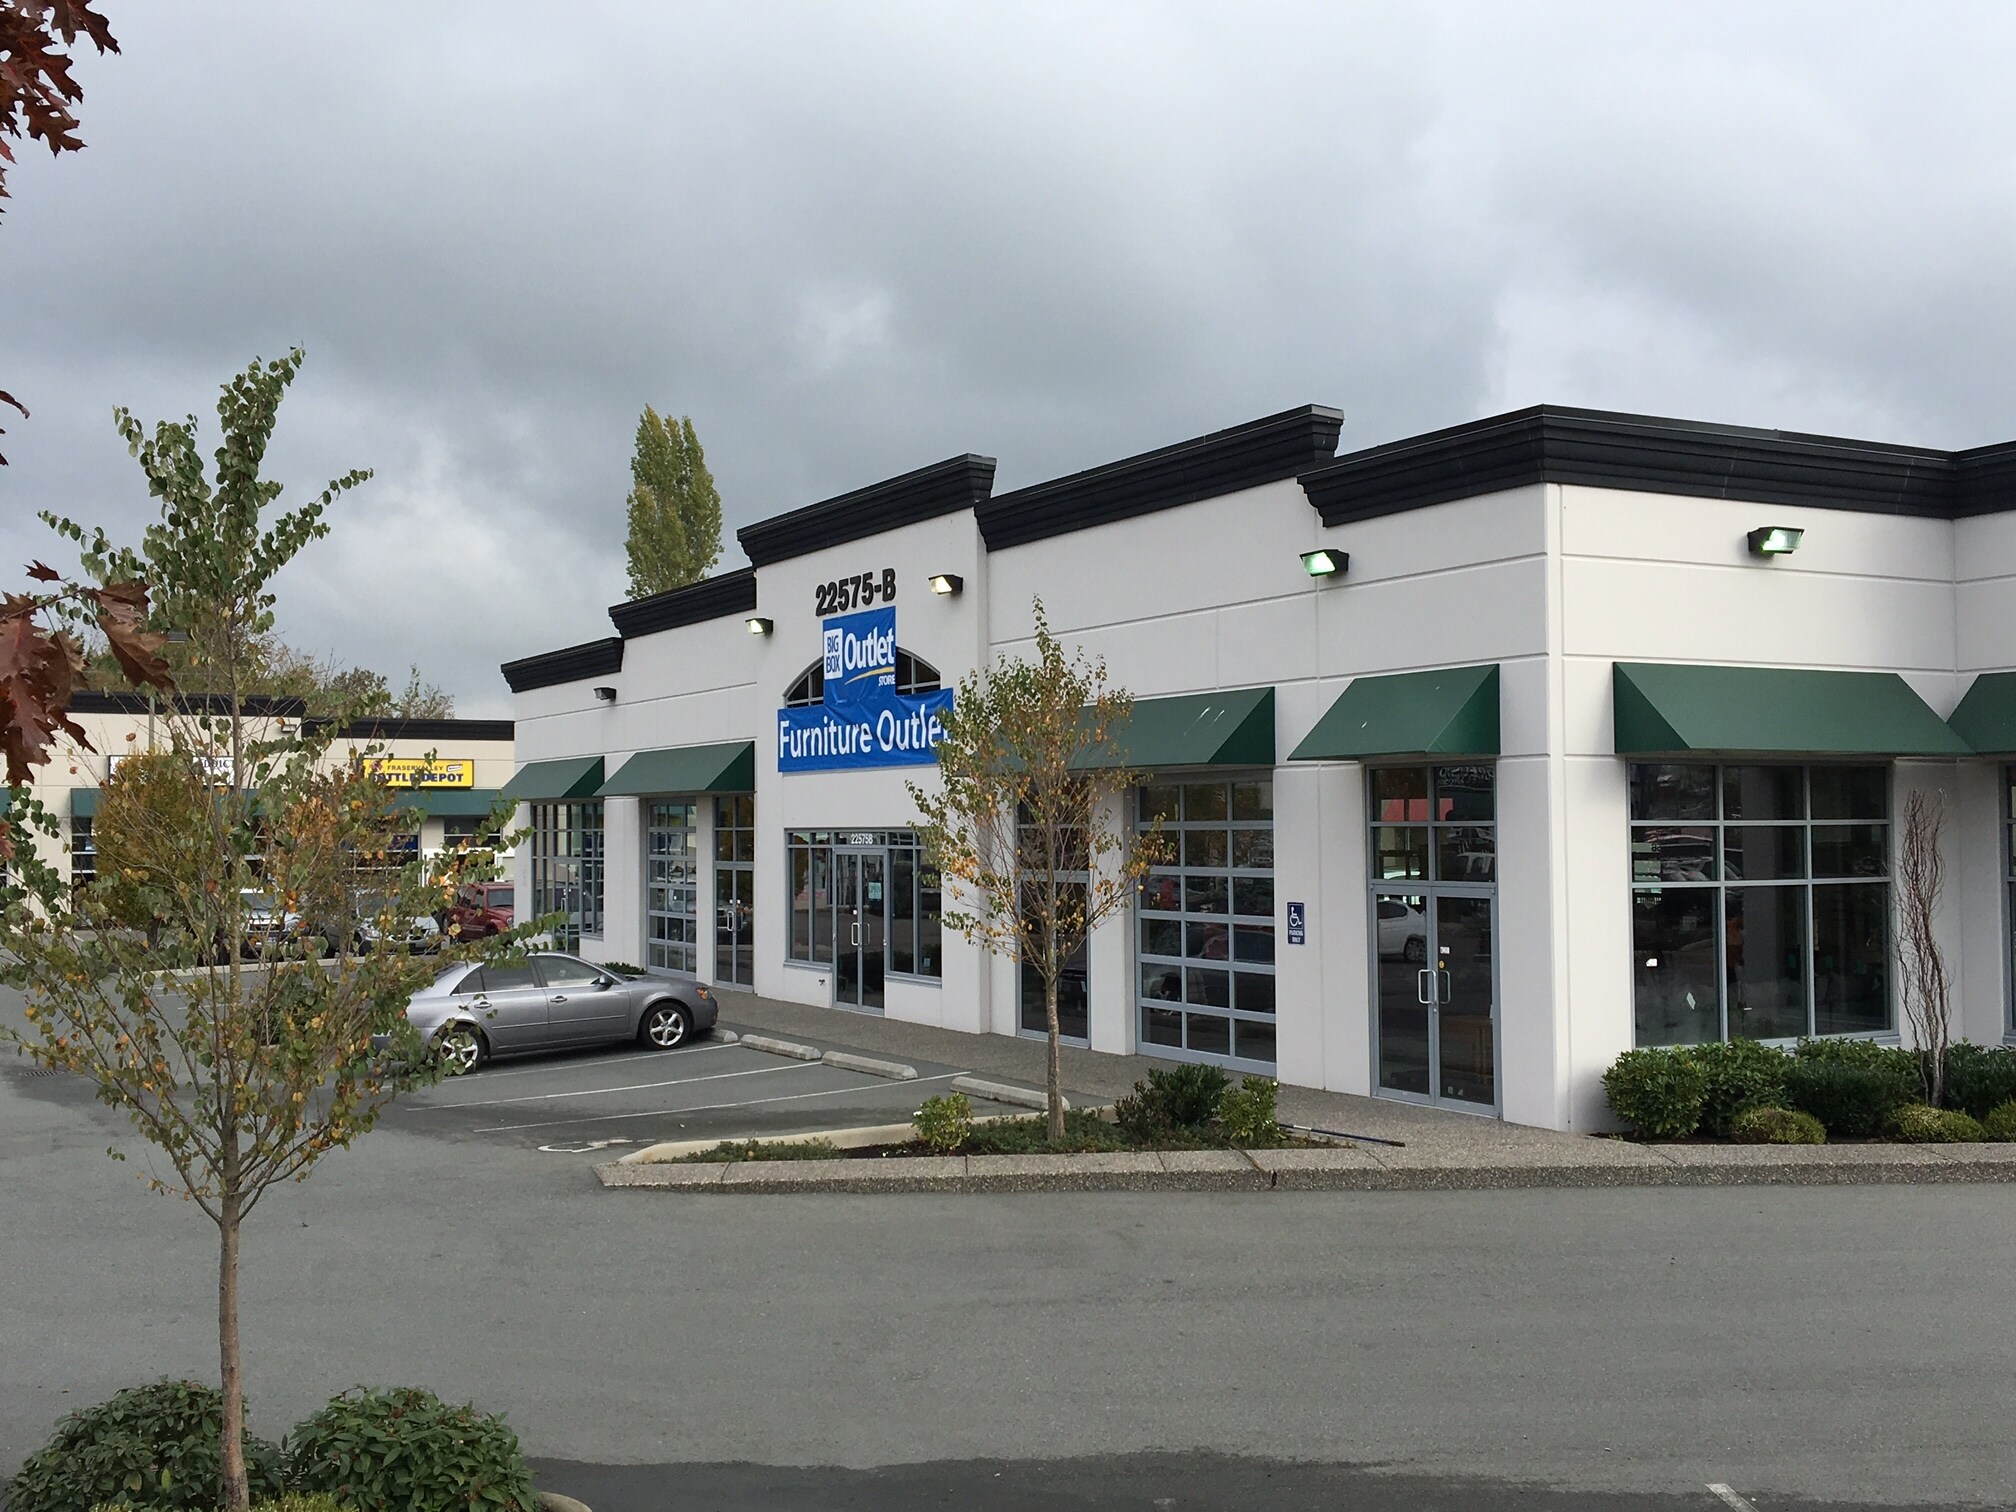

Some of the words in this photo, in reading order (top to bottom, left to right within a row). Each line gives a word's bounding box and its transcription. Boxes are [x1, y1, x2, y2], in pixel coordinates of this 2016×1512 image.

[815, 568, 896, 616] 22575-B
[827, 635, 839, 653] BIG
[844, 626, 895, 670] Outlet
[826, 654, 840, 673] BOX
[878, 675, 896, 687] STORE
[779, 715, 873, 758] Furniture
[422, 773, 464, 782] DEPOT
